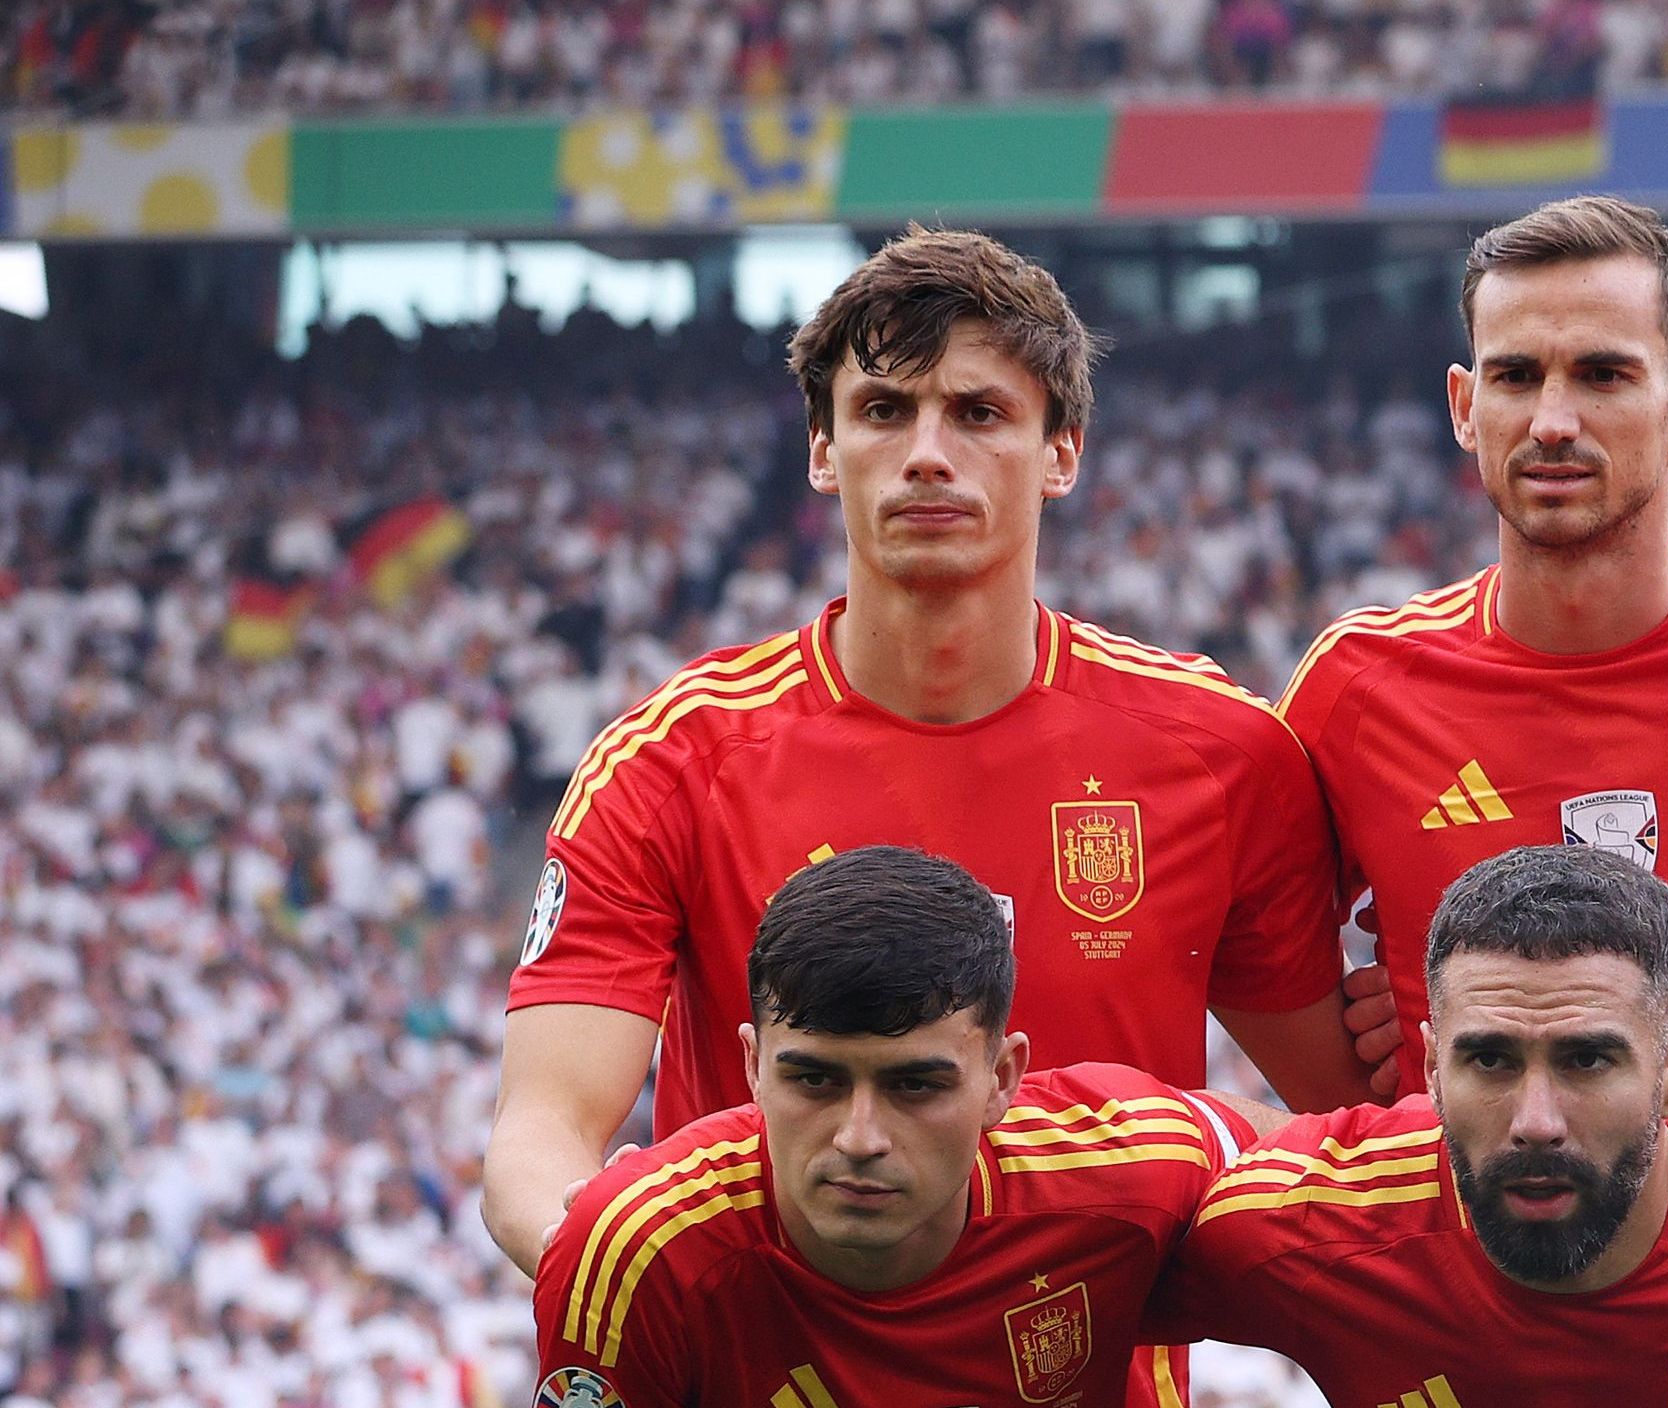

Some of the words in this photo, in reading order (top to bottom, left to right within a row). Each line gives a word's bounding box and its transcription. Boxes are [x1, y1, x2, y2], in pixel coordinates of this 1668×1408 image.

[1565, 801, 1584, 811] UEFA
[1585, 795, 1619, 805] NATIONS
[1619, 794, 1649, 802] LEAGUE
